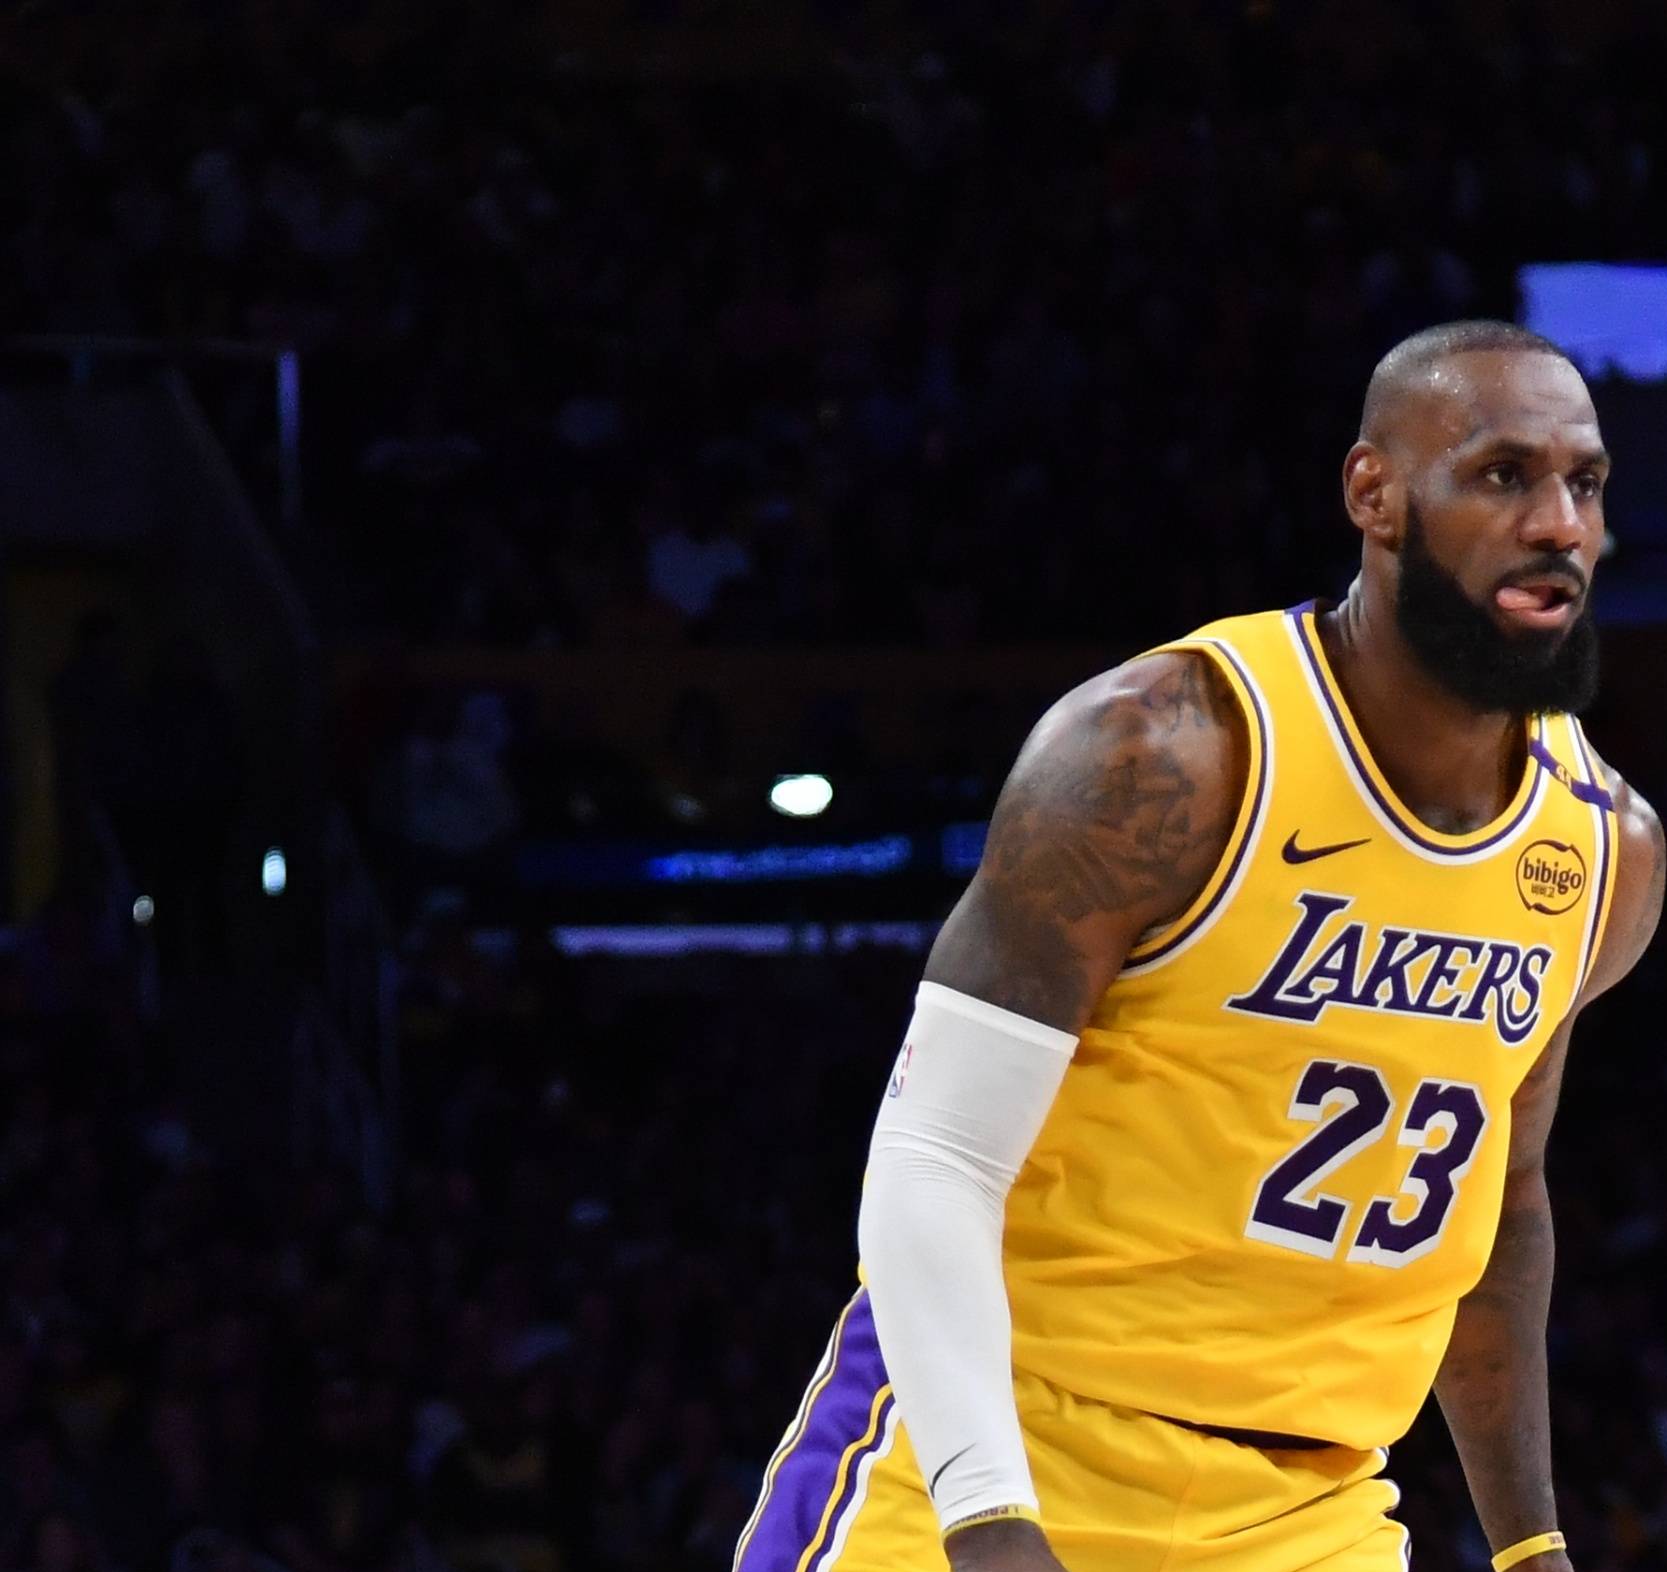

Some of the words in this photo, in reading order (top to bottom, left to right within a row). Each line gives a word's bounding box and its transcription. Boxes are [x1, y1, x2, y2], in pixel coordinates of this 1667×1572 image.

[1523, 857, 1582, 895] bibigo
[1223, 890, 1552, 1044] LAKERS
[1244, 1057, 1490, 1269] 23
